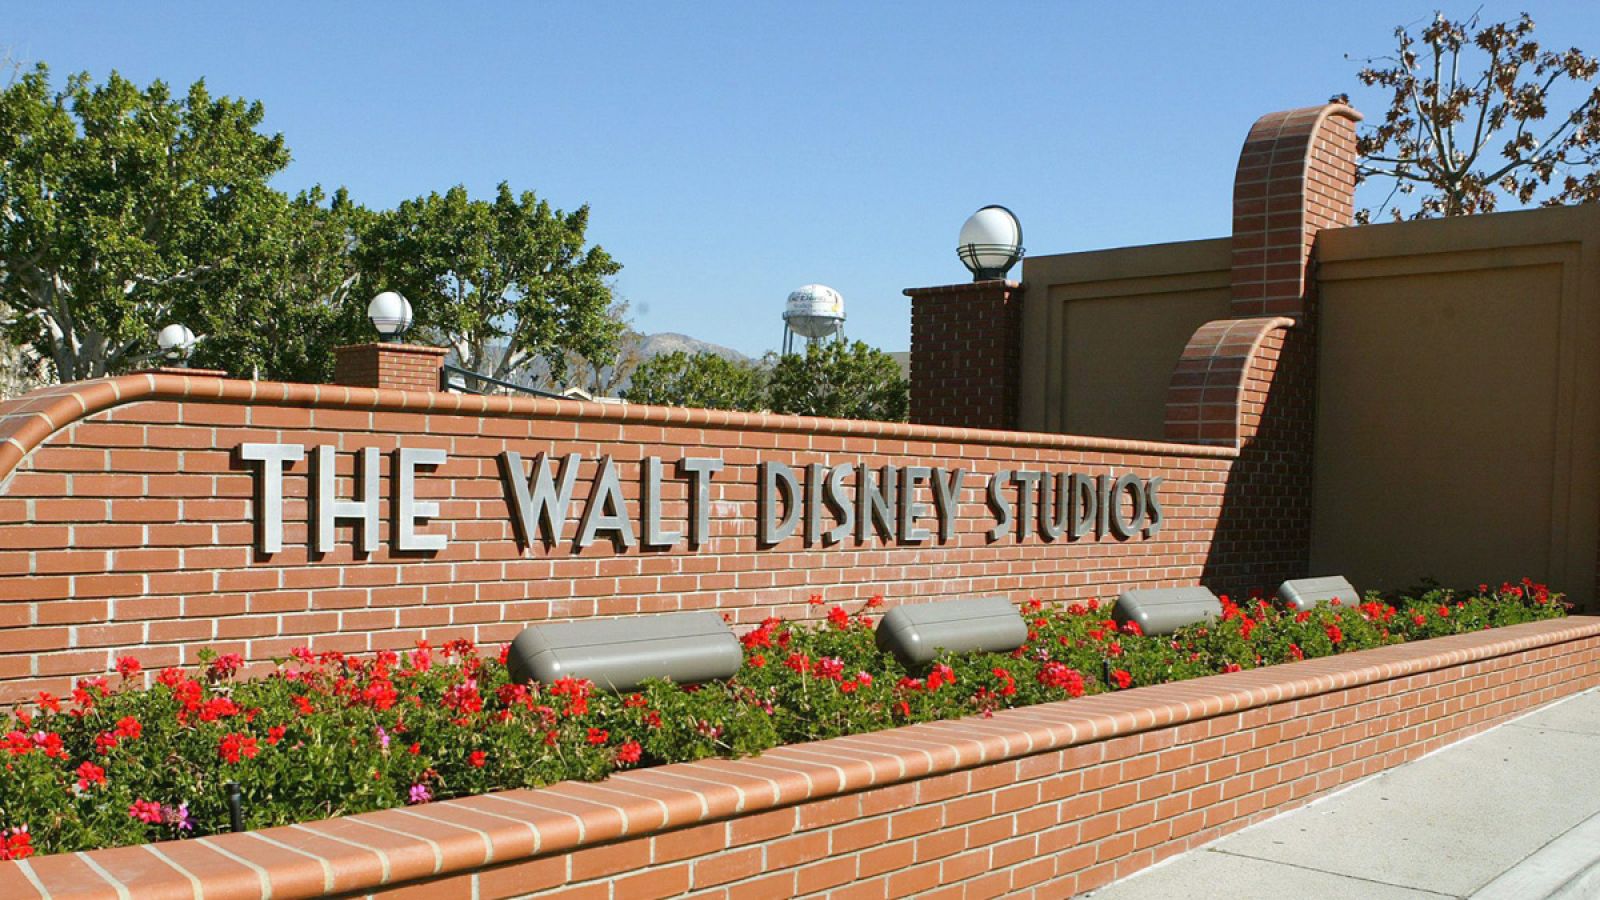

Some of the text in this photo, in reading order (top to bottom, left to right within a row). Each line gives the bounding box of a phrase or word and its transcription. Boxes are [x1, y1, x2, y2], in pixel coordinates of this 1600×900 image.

[239, 443, 1163, 553] THE WALT DISNEY STUDIOS
